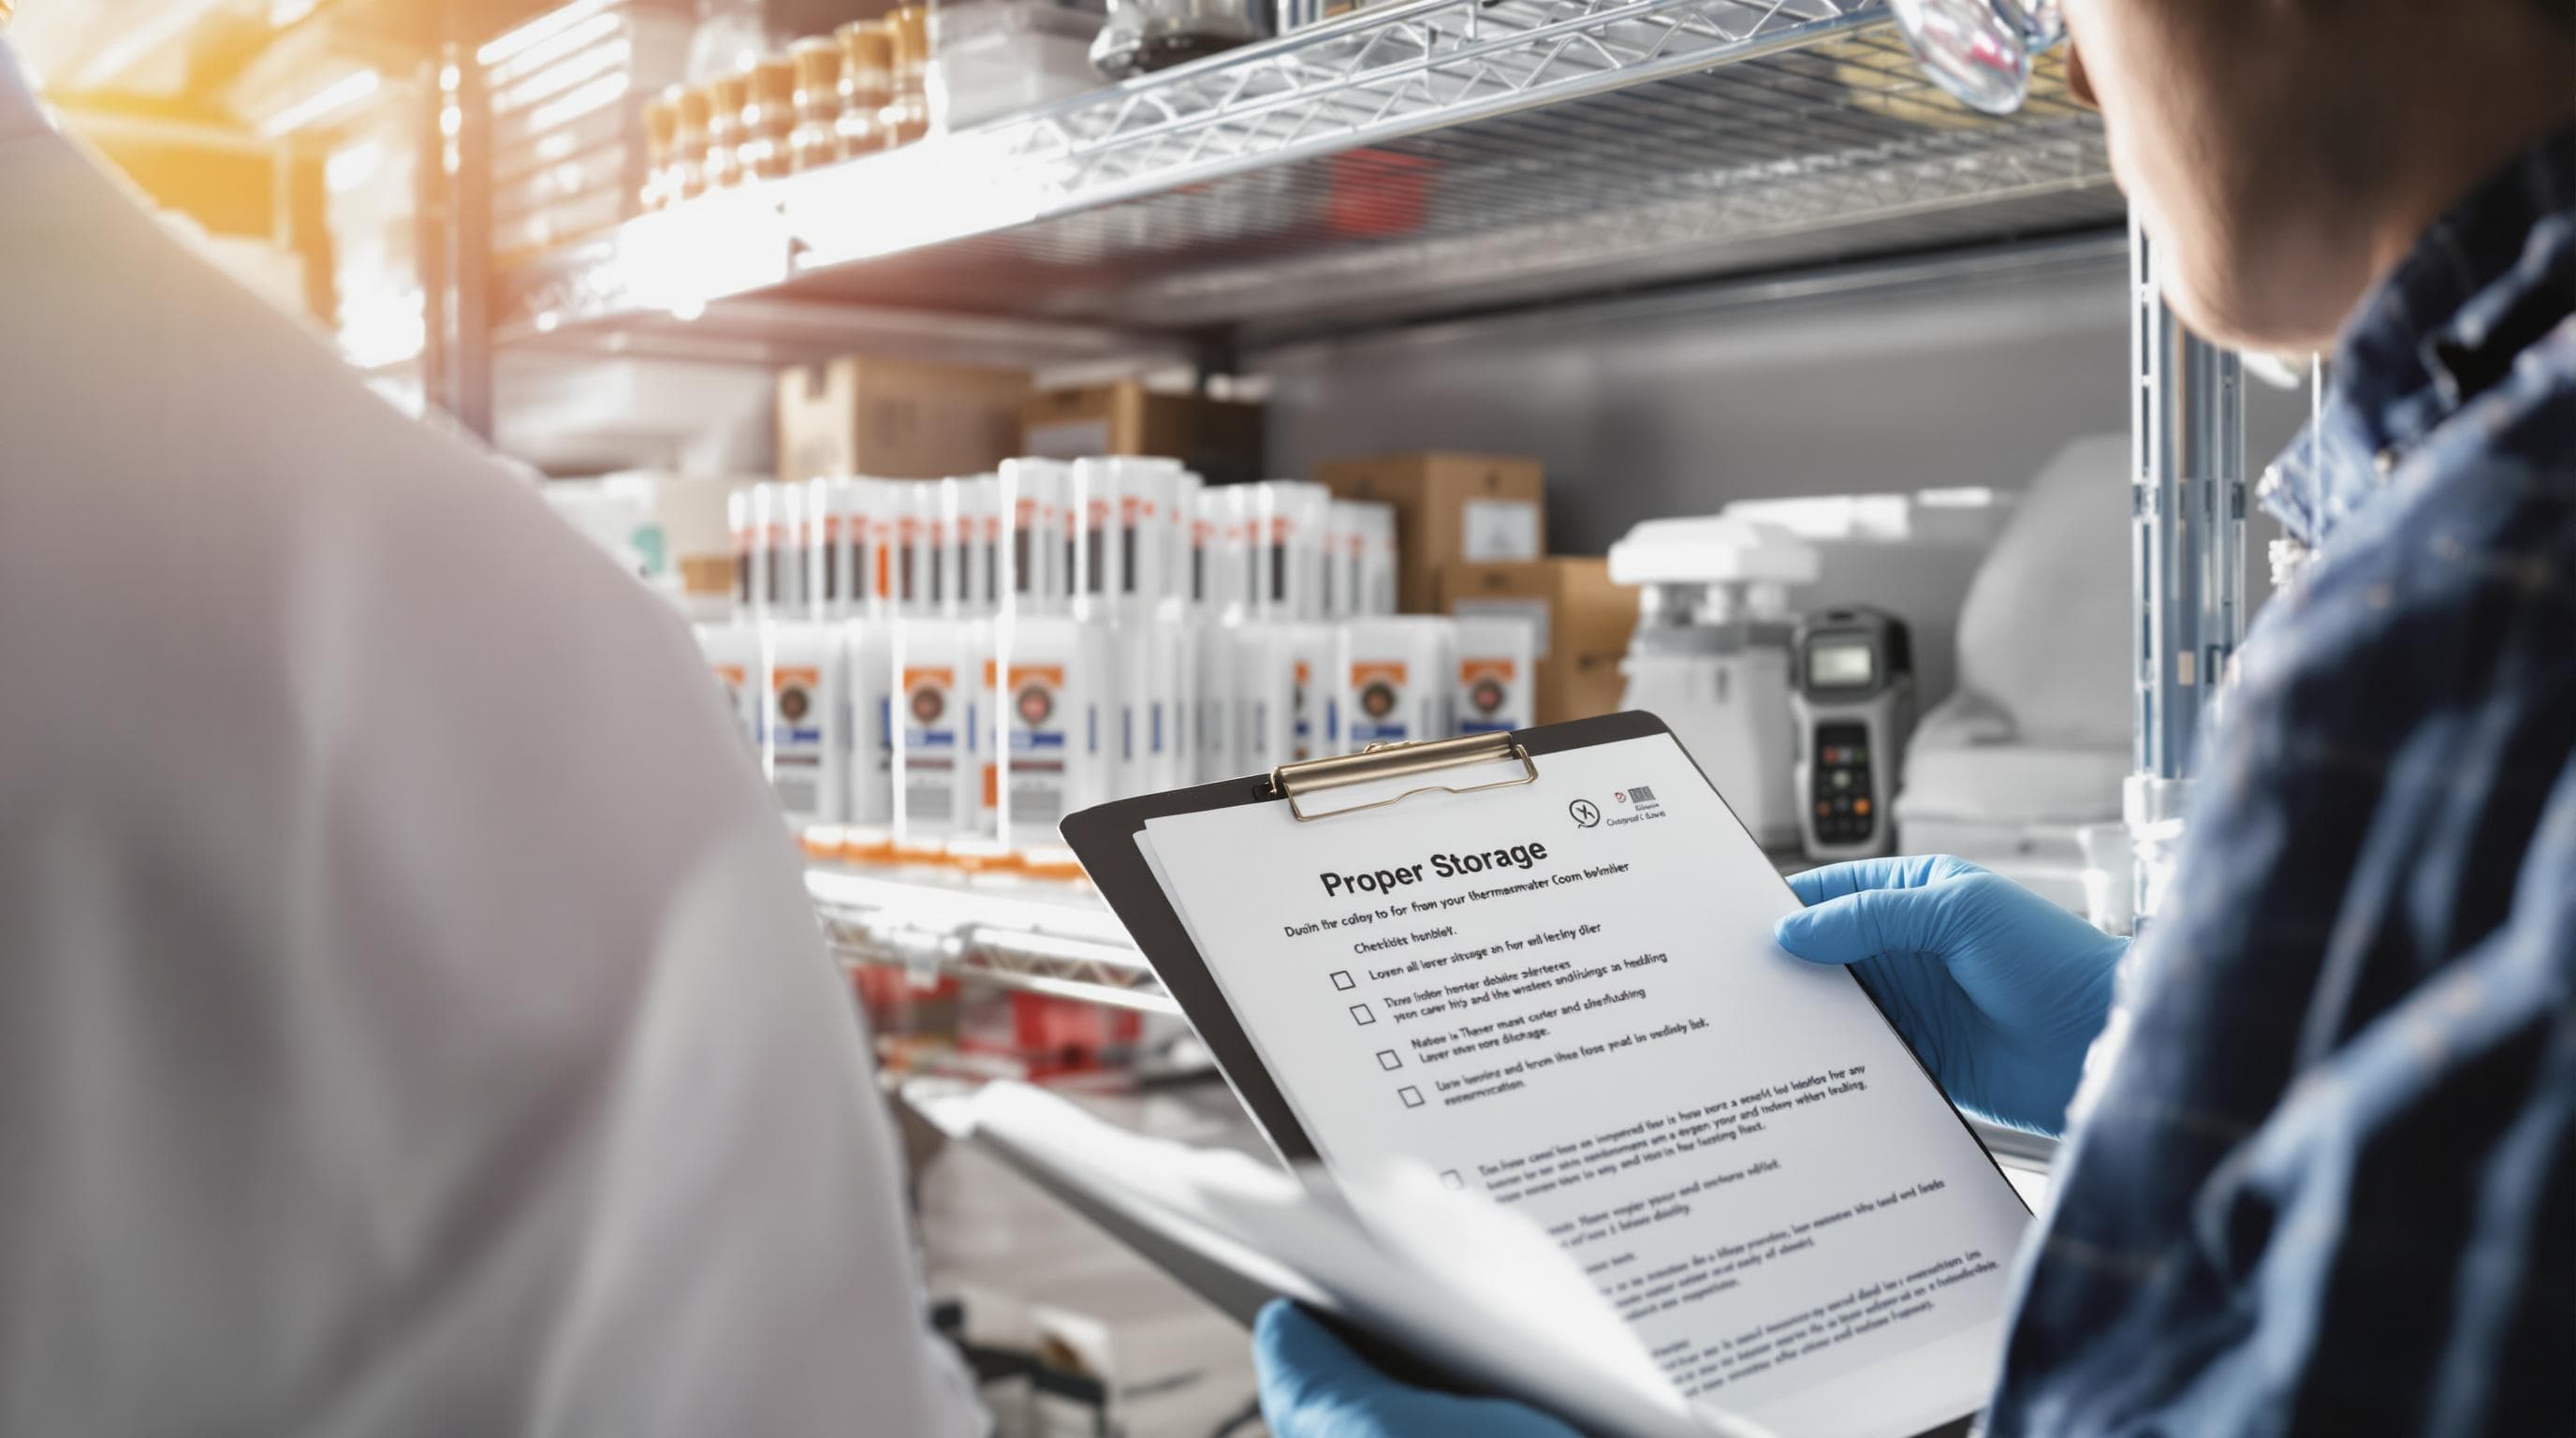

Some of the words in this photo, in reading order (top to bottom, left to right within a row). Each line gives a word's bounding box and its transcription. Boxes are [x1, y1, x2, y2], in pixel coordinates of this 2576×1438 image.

[1319, 863, 1423, 898] Proper
[1430, 843, 1548, 878] Storage
[1374, 910, 1389, 919] to
[1390, 905, 1408, 917] for
[1439, 895, 1466, 910] your
[1471, 991, 1491, 1005] and
[1560, 1001, 1582, 1015] and
